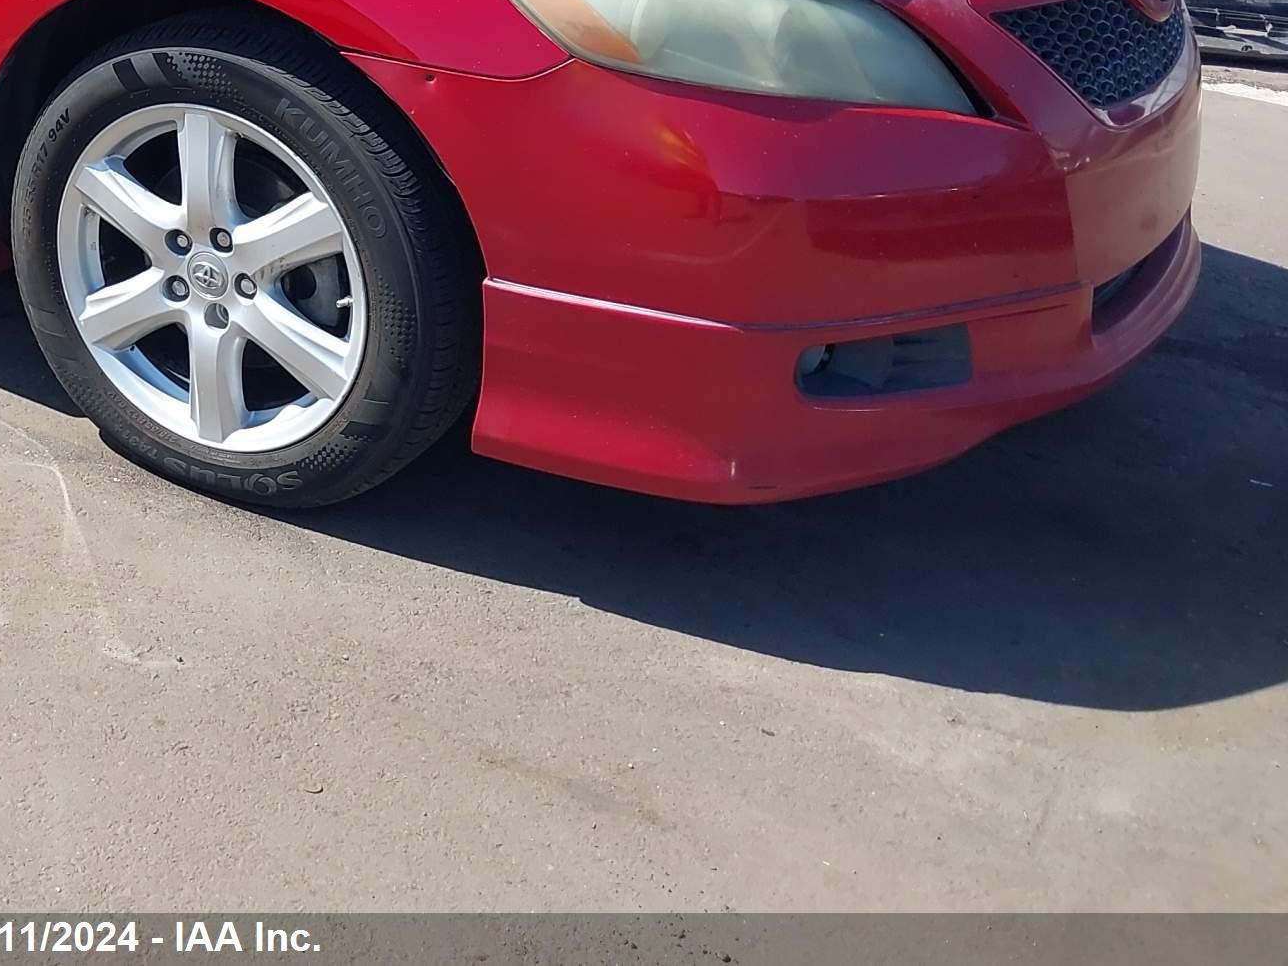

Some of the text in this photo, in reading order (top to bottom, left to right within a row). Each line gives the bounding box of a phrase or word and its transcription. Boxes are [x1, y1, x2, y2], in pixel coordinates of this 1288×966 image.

[48, 107, 71, 143] 94V
[274, 97, 387, 238] KUMHO
[163, 457, 304, 496] SOLUS
